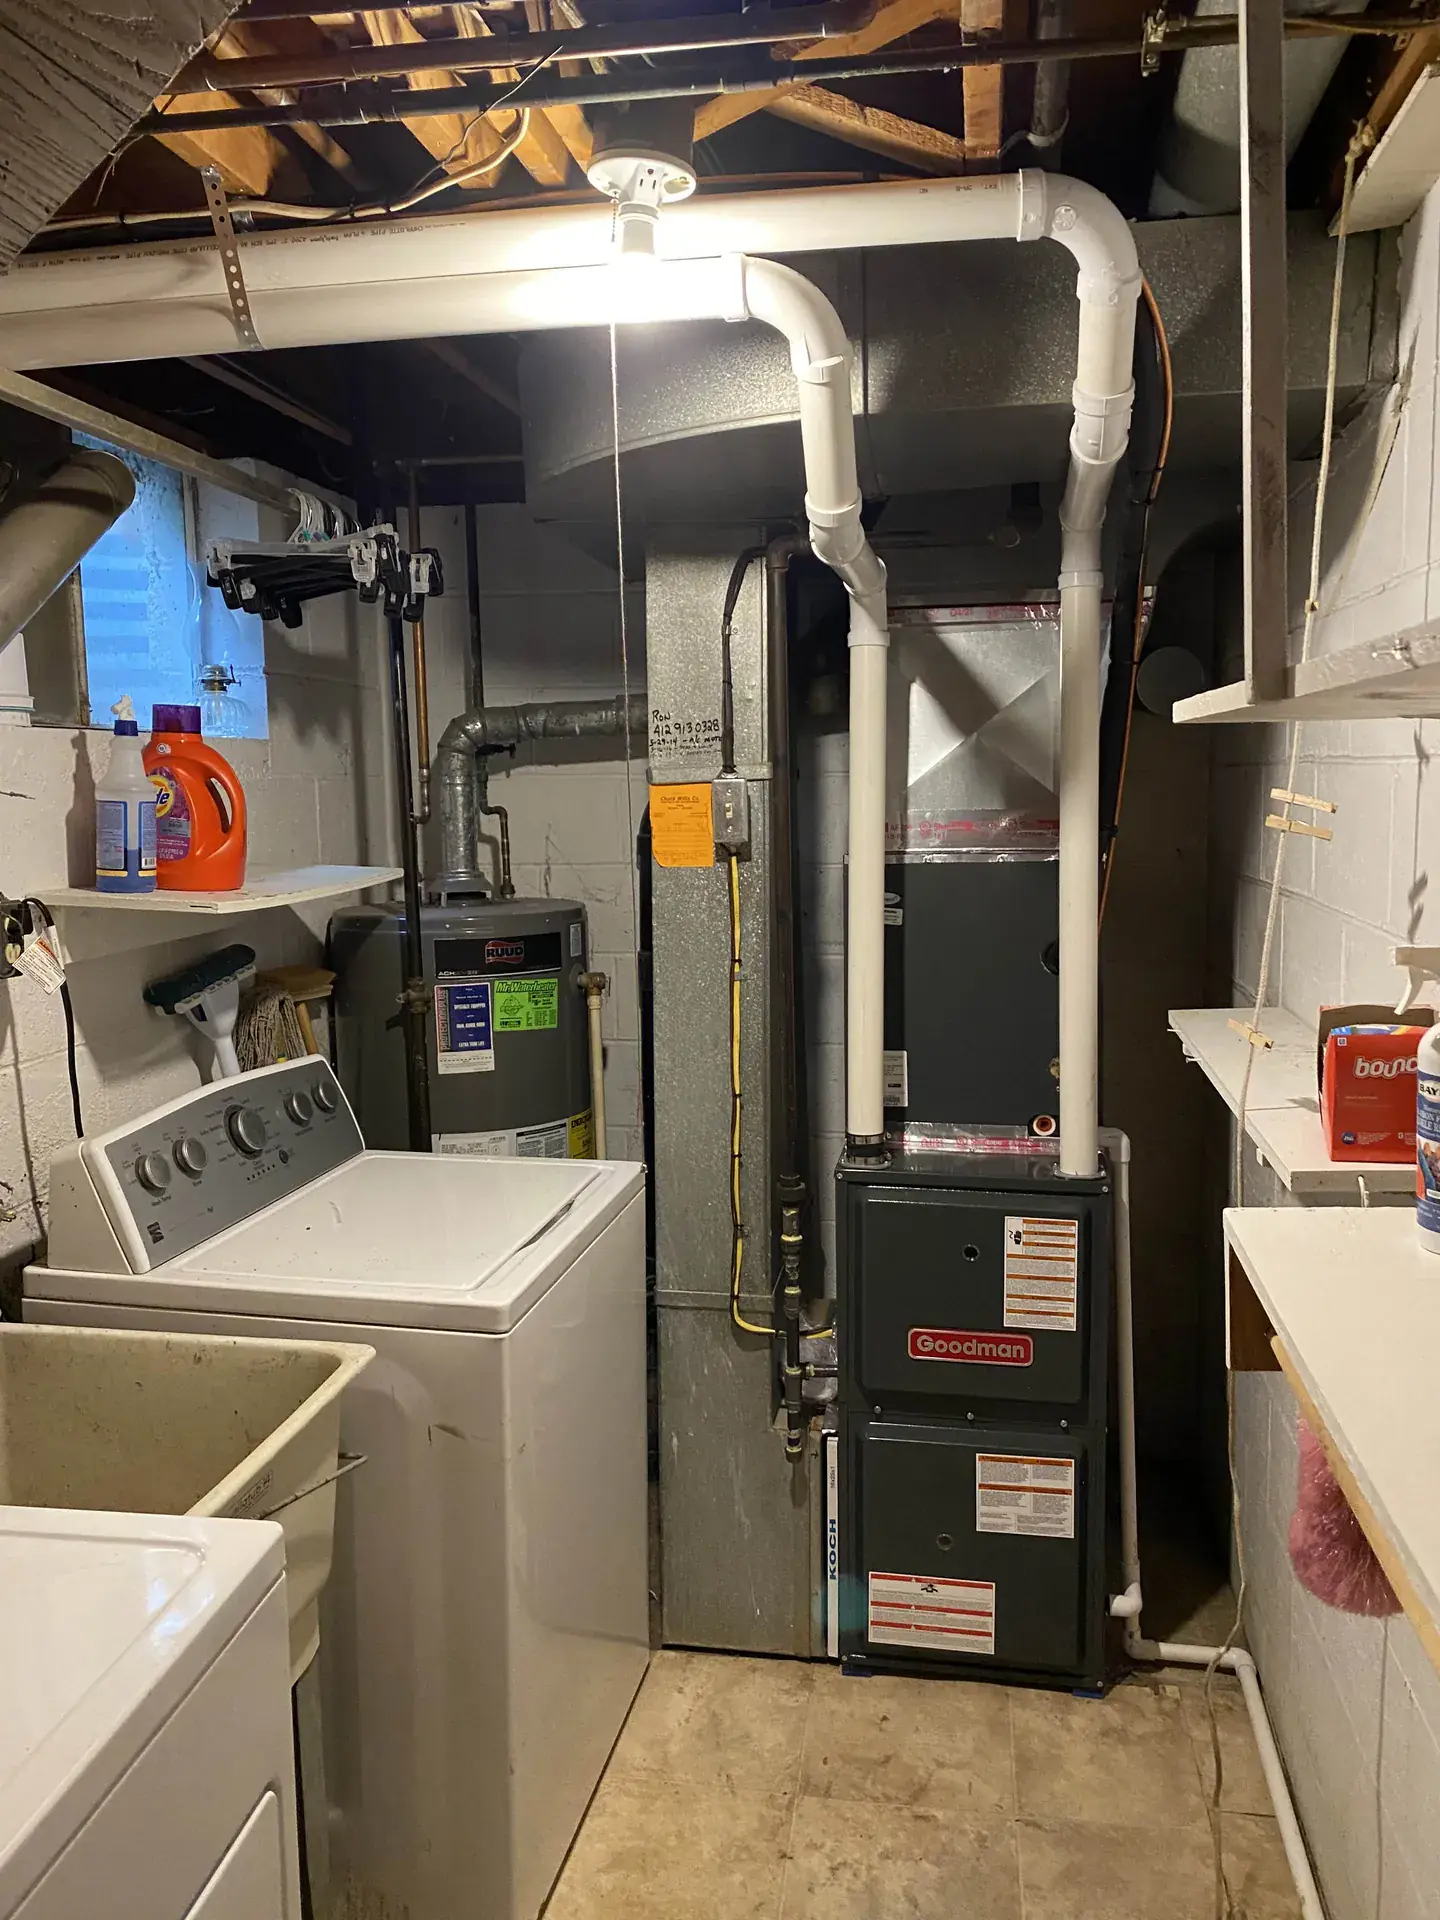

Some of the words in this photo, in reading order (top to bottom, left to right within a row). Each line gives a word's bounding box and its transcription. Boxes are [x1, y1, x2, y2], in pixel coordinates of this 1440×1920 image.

[674, 722, 692, 734] 913
[694, 718, 720, 733] 0328
[486, 946, 524, 958] RUUD
[1354, 1056, 1418, 1078] bounc
[916, 1335, 1025, 1360] Goodman
